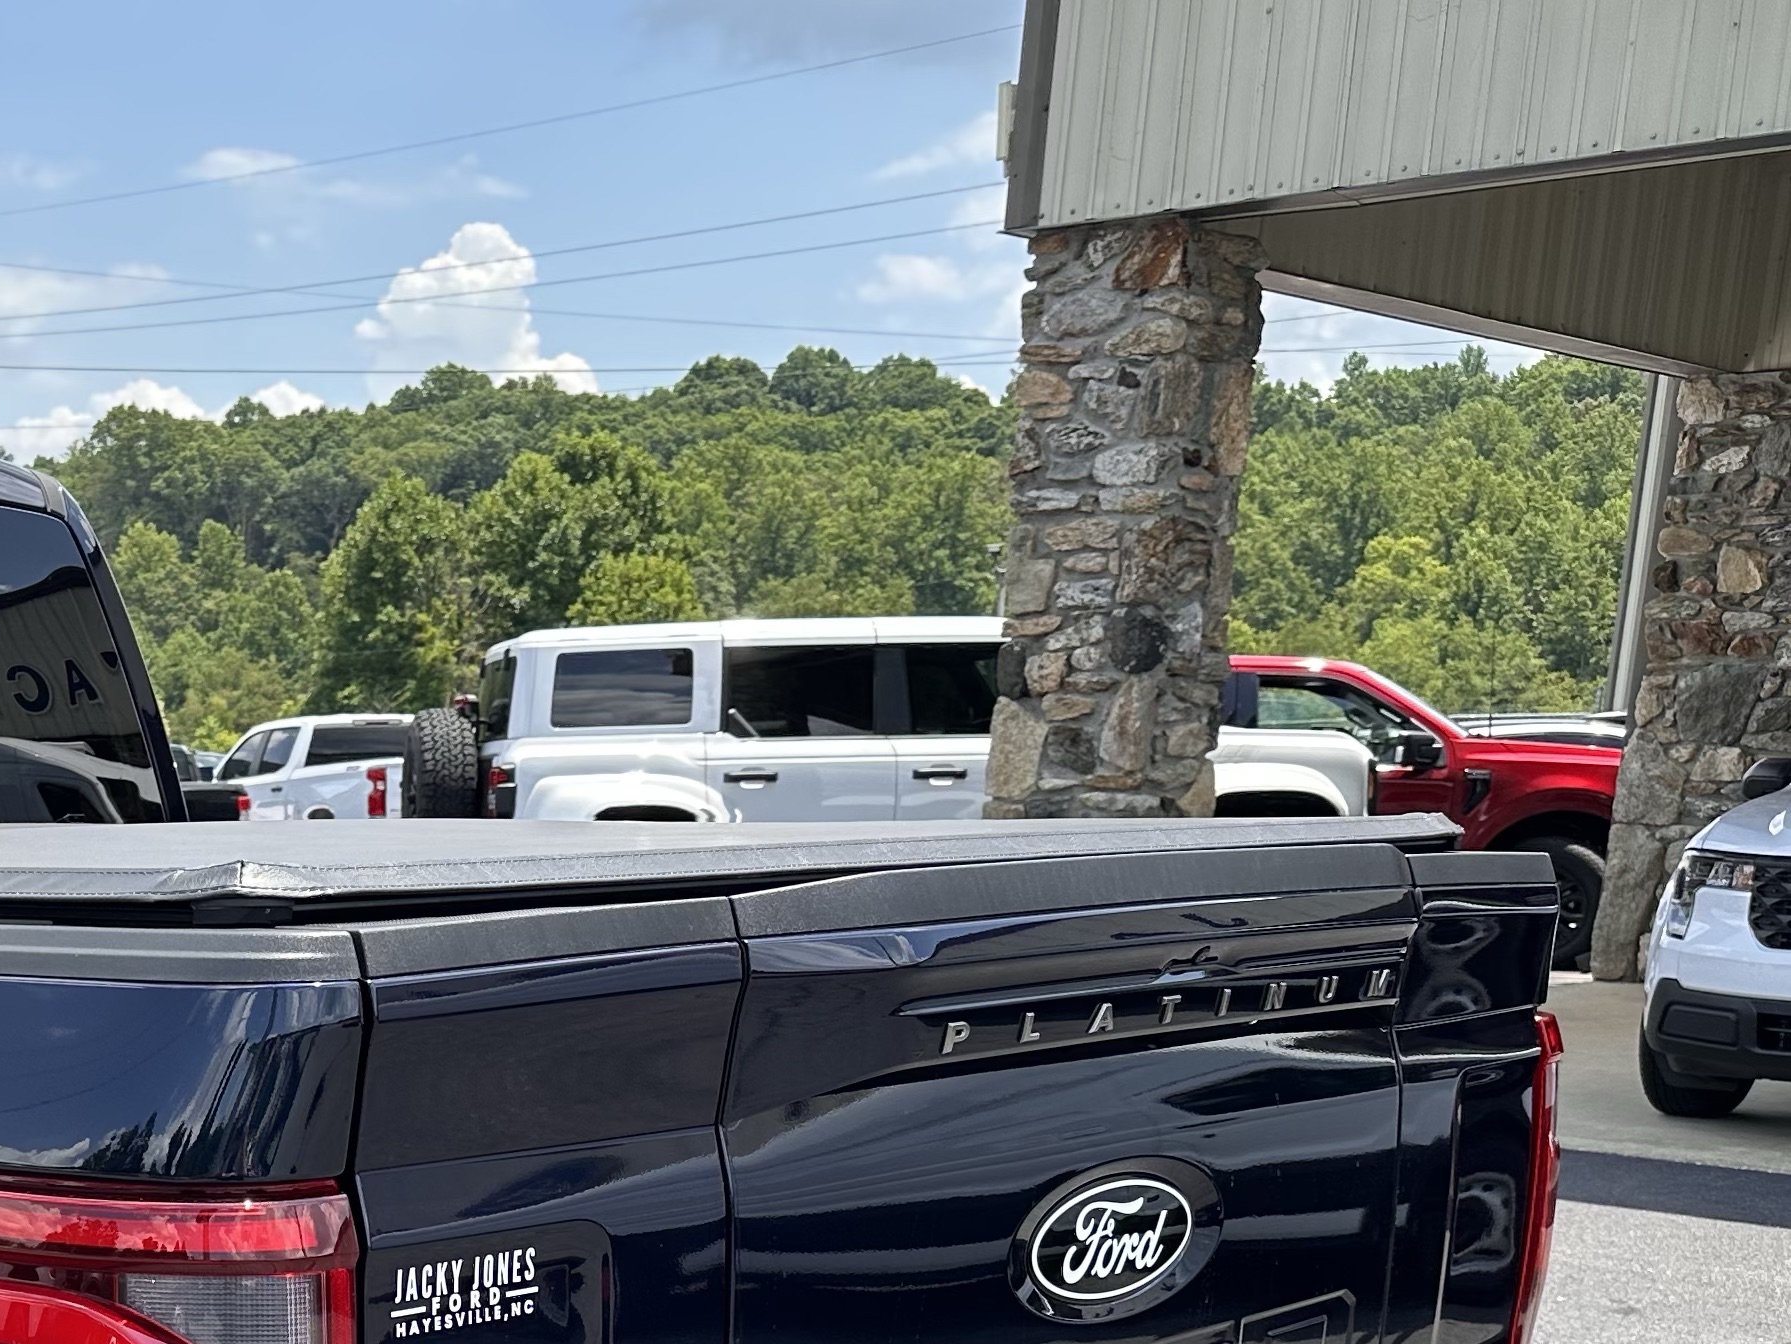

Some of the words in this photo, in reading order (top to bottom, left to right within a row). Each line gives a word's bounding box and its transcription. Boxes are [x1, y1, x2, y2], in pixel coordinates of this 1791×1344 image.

[940, 968, 1392, 1055] PLATINUM
[395, 1258, 465, 1304] JACKY
[472, 1247, 536, 1291] JONES
[1063, 1196, 1169, 1285] Ford
[431, 1287, 502, 1317] FORD
